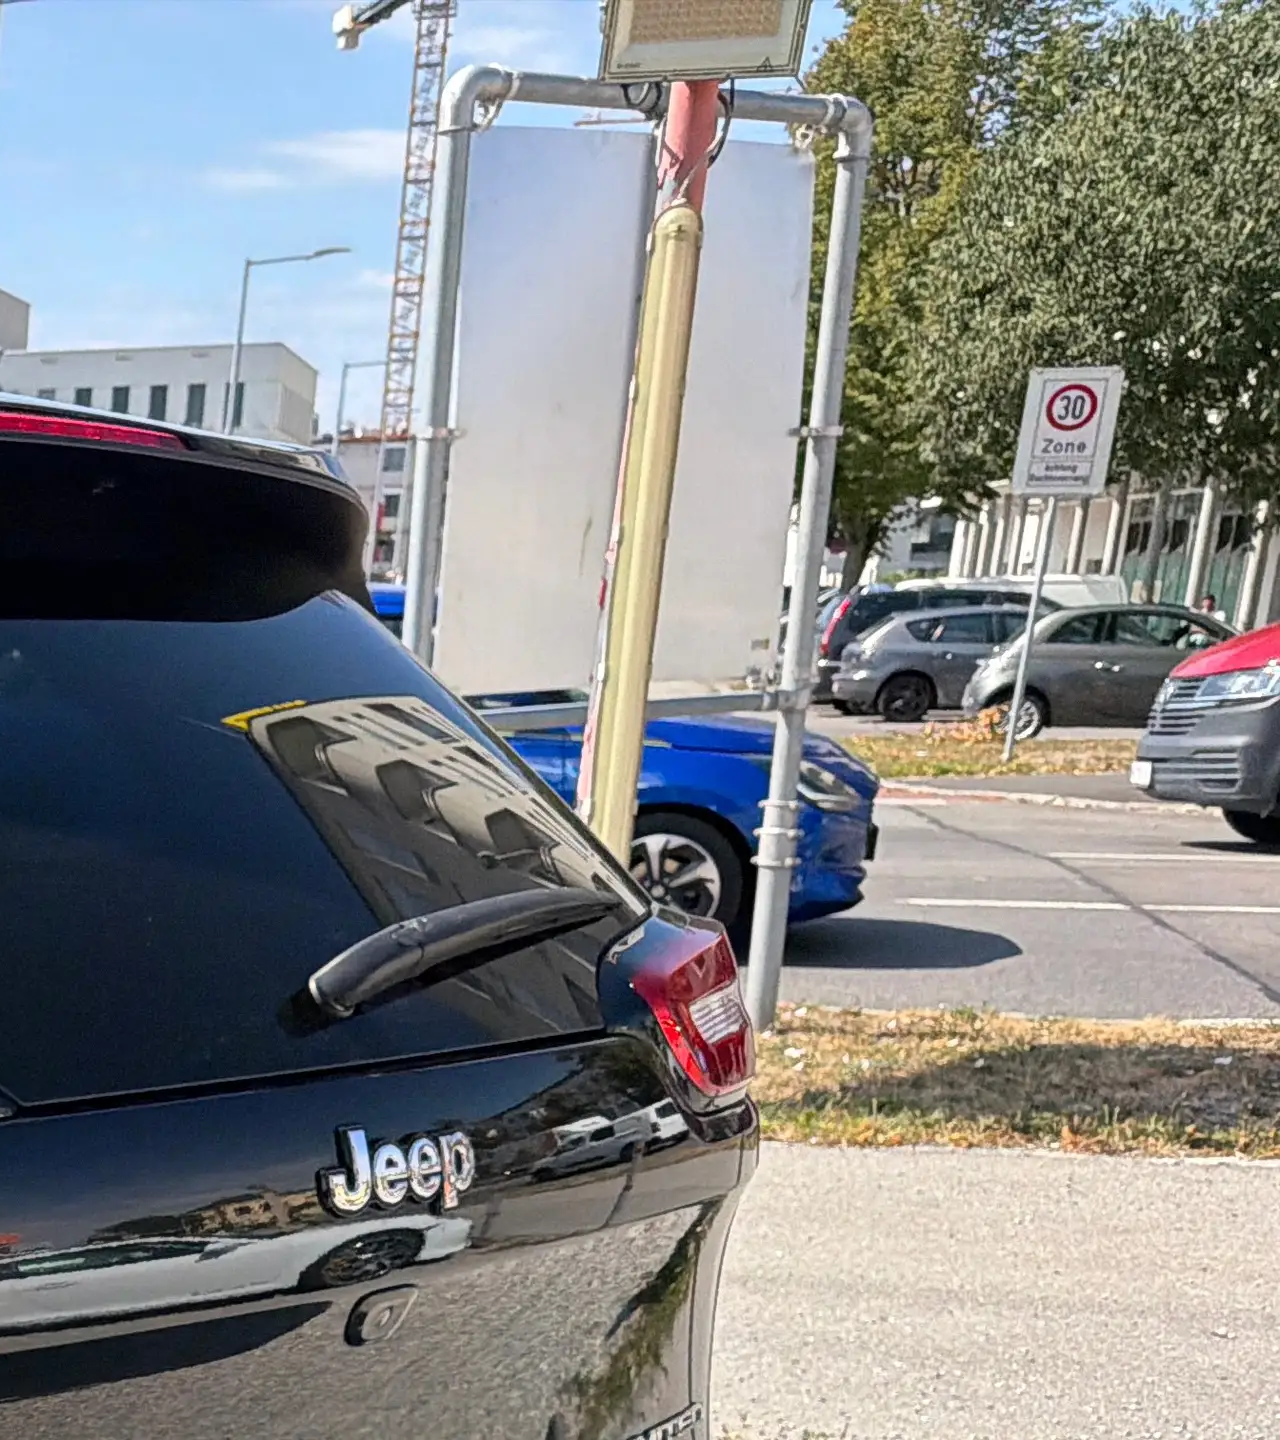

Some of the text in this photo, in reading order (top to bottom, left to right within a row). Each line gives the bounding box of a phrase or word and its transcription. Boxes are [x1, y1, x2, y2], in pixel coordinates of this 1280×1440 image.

[1057, 395, 1087, 421] 30
[1041, 438, 1087, 454] Zone
[326, 1127, 476, 1211] Jeep
